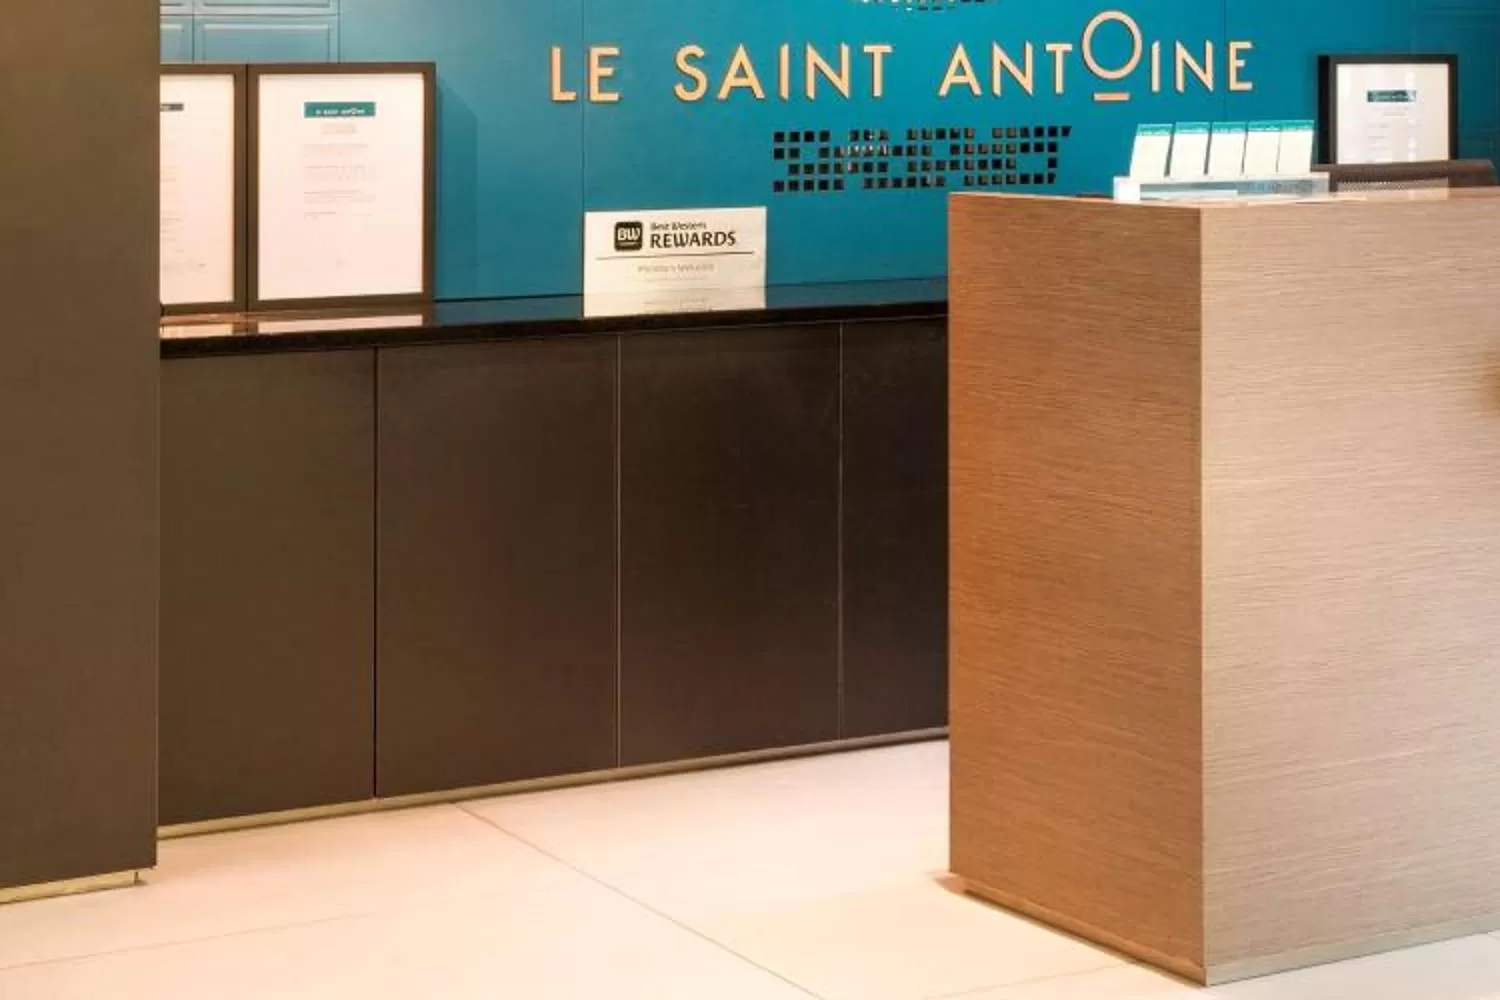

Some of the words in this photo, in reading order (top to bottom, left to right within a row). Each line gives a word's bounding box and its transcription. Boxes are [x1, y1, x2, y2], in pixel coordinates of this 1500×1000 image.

[551, 46, 620, 102] LE
[672, 42, 893, 102] SAINT
[937, 9, 1253, 101] ANTOINE
[650, 231, 736, 248] REWARDS
